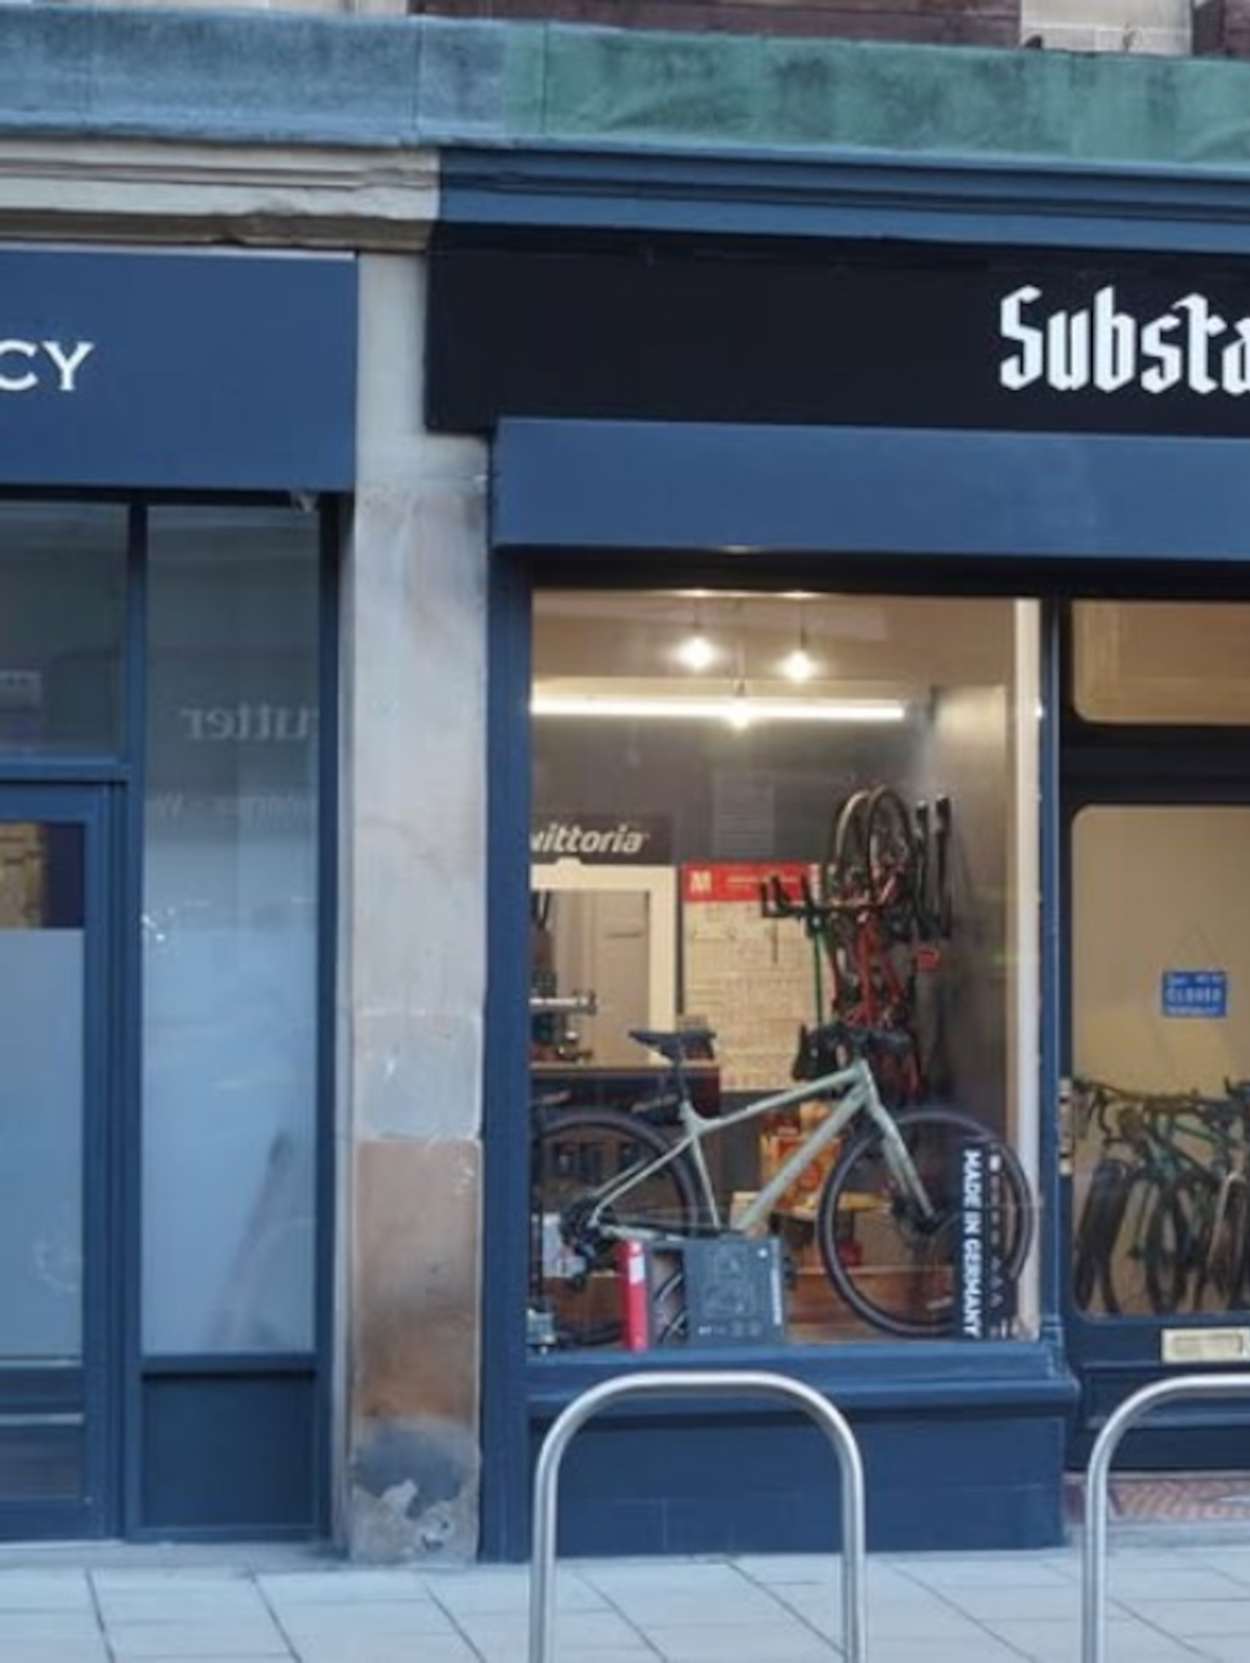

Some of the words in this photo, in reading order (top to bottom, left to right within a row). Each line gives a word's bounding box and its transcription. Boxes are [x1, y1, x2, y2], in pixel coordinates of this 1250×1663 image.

[0, 338, 95, 392] CY
[962, 1149, 983, 1209] MADE
[963, 1211, 982, 1235] IN
[963, 1237, 983, 1339] GERMANY
